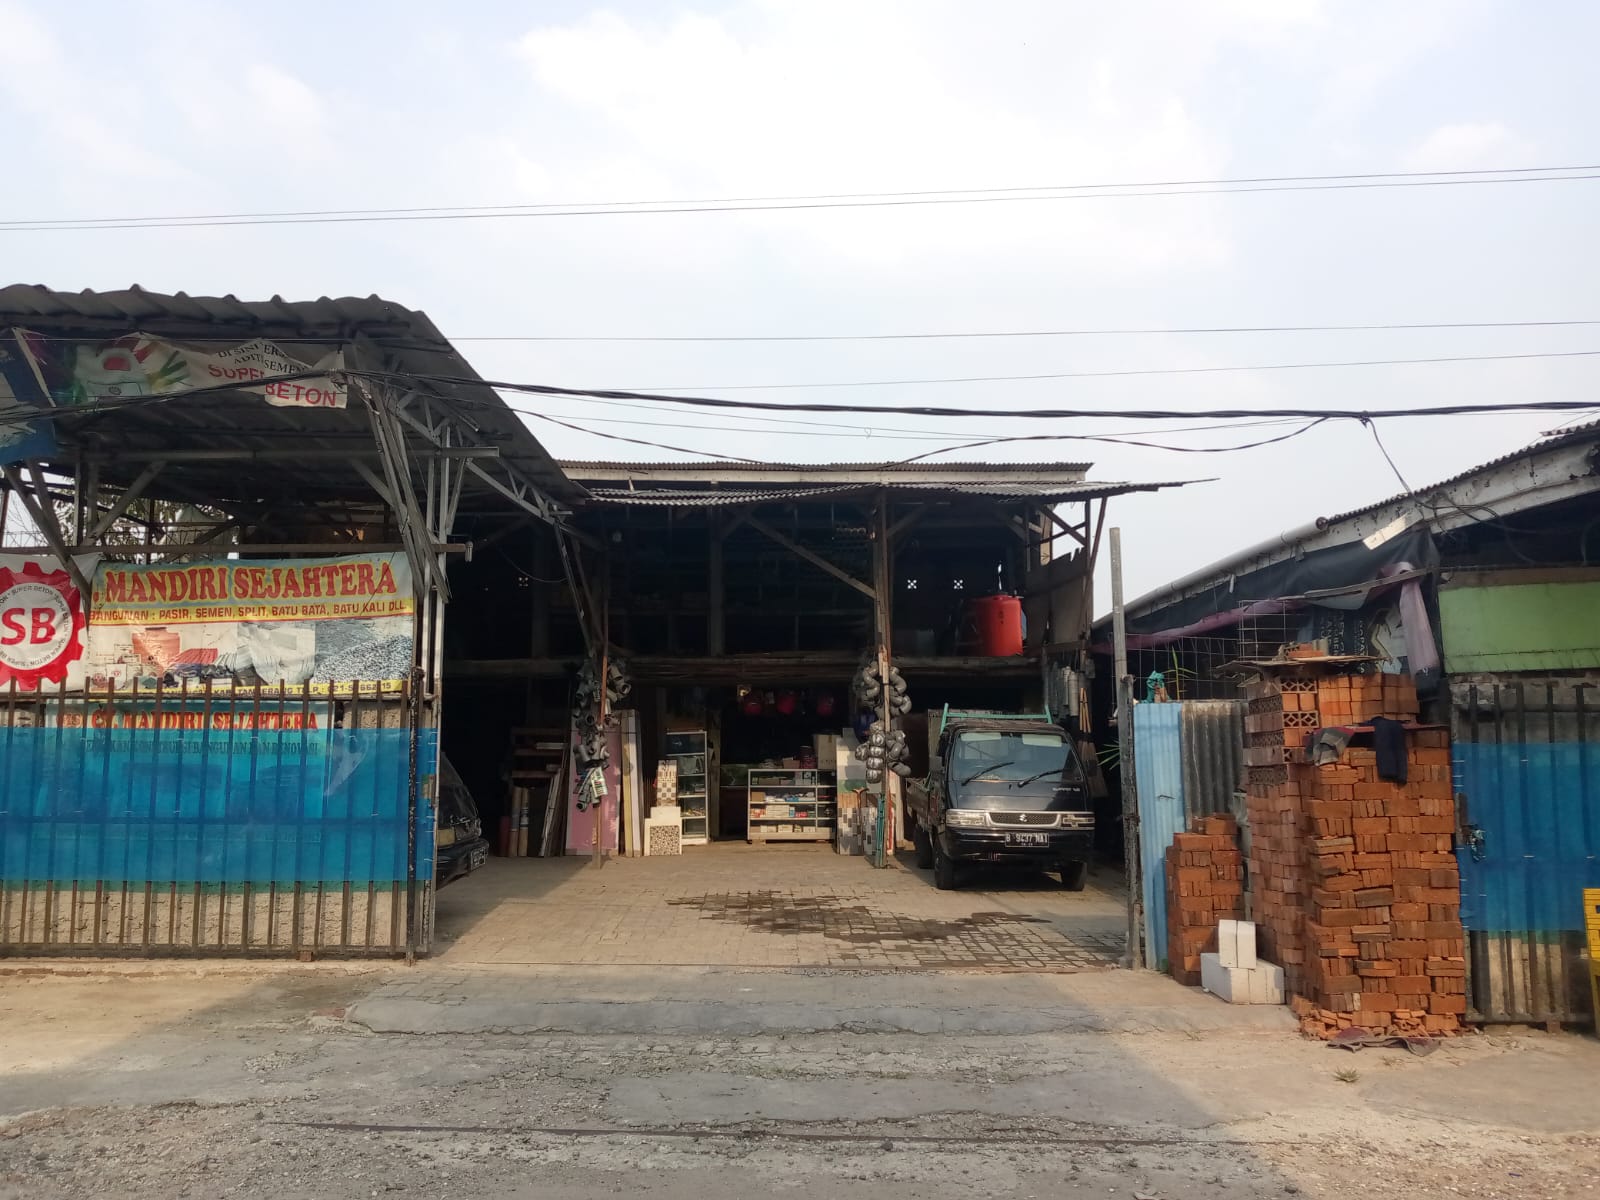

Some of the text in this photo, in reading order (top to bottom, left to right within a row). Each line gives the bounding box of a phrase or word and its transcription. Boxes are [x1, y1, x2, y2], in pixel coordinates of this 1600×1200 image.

[265, 381, 337, 407] BETON
[105, 562, 397, 603] MANDIRI SEJAHTERA
[272, 605, 298, 616] BATU
[333, 603, 359, 614] BATU
[363, 601, 385, 613] KALI
[1, 608, 56, 645] SB
